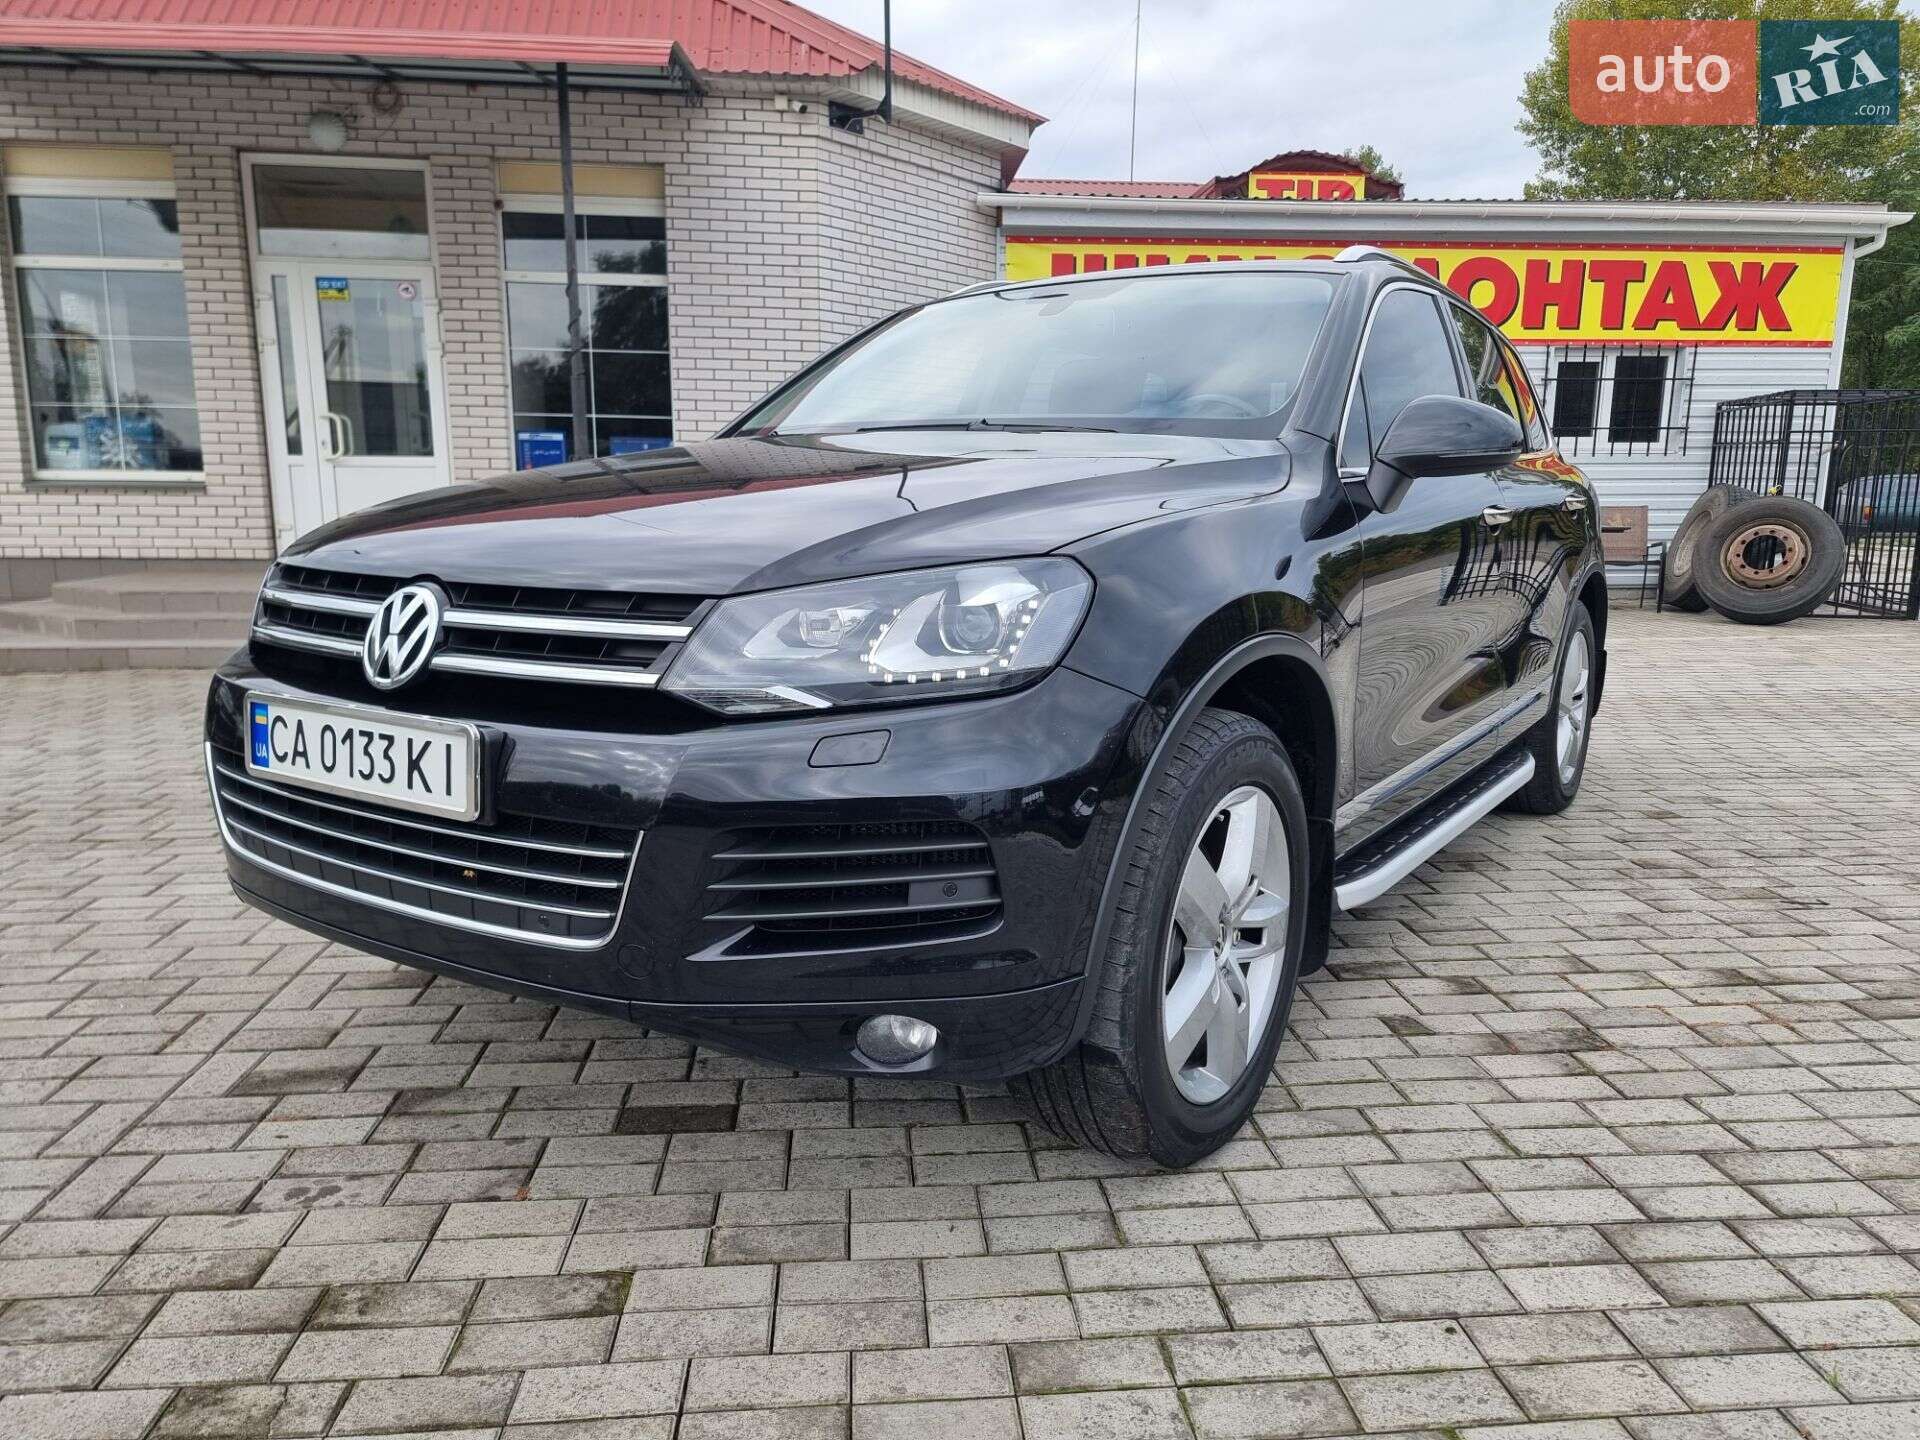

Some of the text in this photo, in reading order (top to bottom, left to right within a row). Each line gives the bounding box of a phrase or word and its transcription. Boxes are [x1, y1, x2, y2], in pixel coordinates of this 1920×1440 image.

[255, 742, 268, 759] UA
[270, 715, 452, 796] CA 0133 KI
